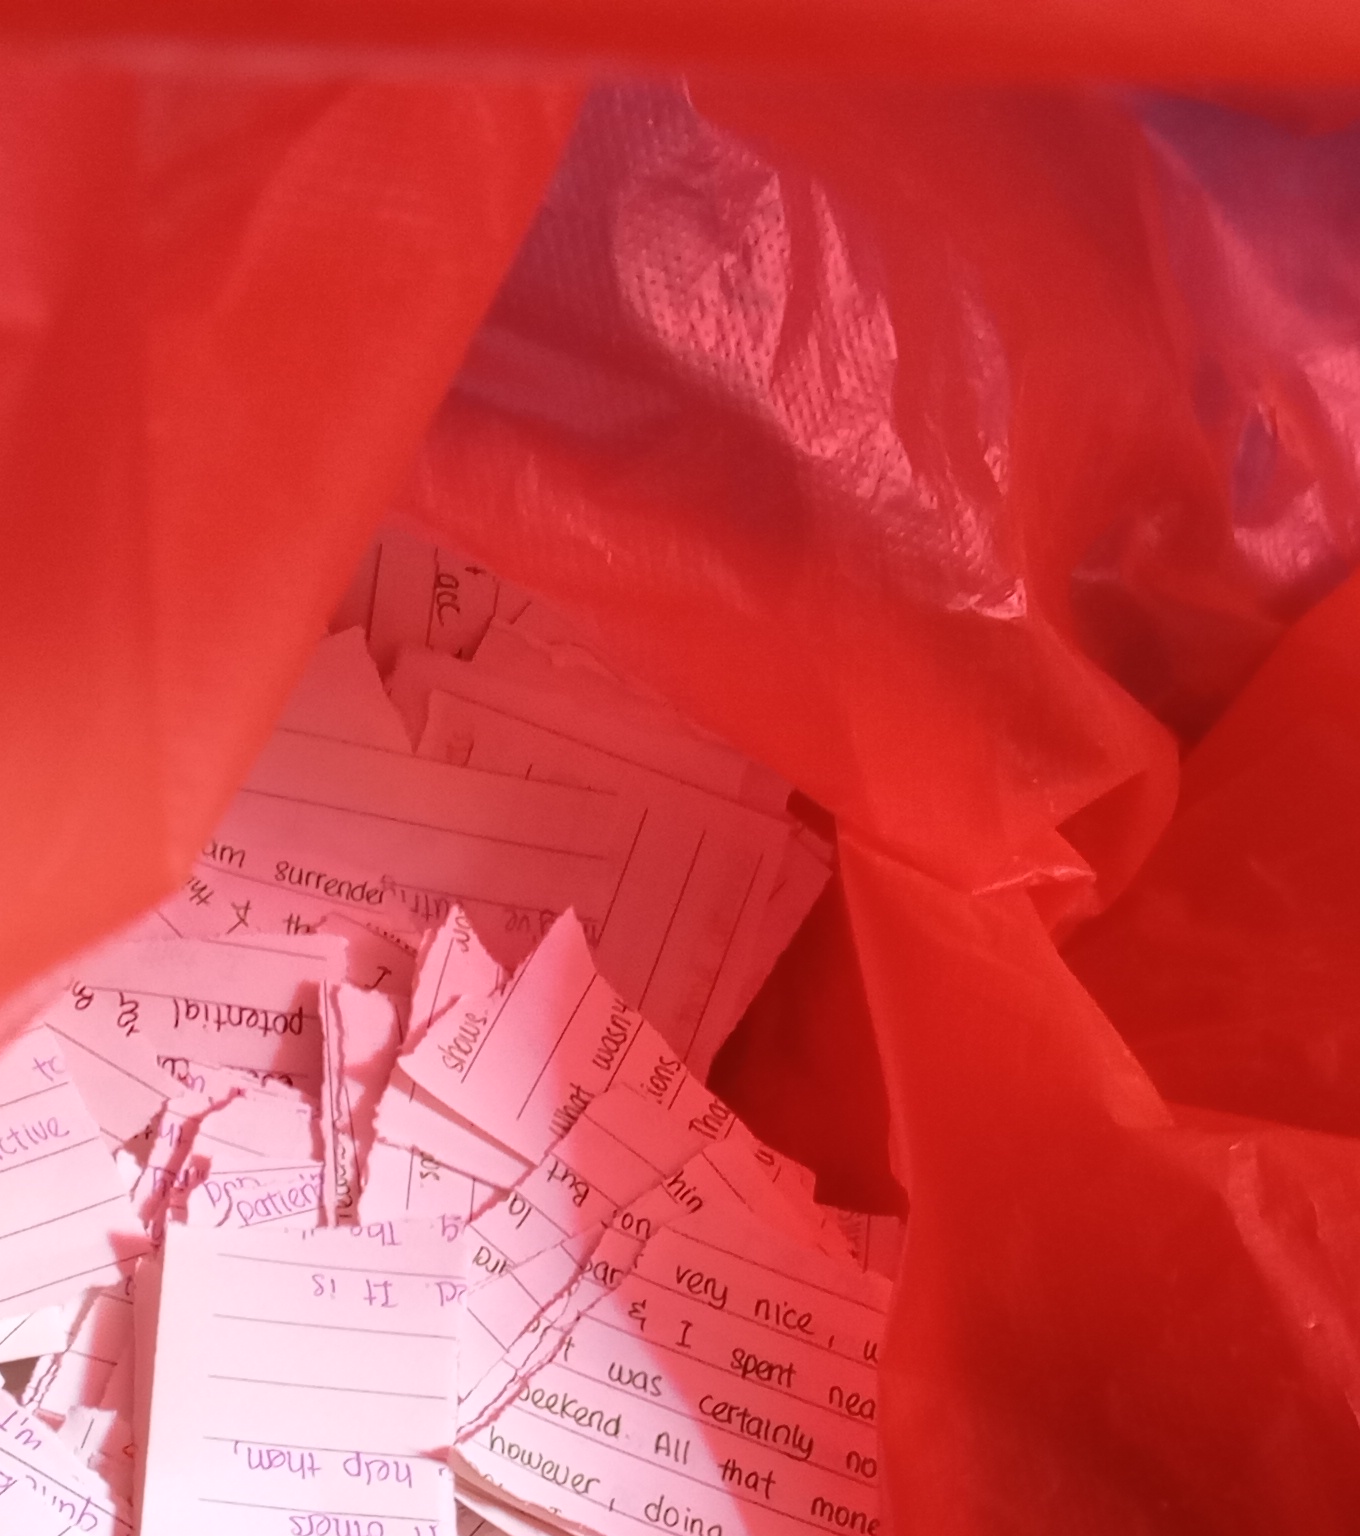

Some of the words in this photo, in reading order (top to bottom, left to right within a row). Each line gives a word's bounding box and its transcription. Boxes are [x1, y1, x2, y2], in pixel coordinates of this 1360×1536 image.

[172, 997, 304, 1037] potential
[311, 1273, 336, 1298] is
[366, 1282, 398, 1308] It
[675, 1261, 729, 1311] very
[675, 1320, 693, 1349] I
[730, 1346, 797, 1389] spent
[607, 1359, 664, 1398] was
[698, 1392, 814, 1462] certainly
[343, 1448, 413, 1489] help
[654, 1431, 692, 1466] All
[718, 1458, 777, 1500] that
